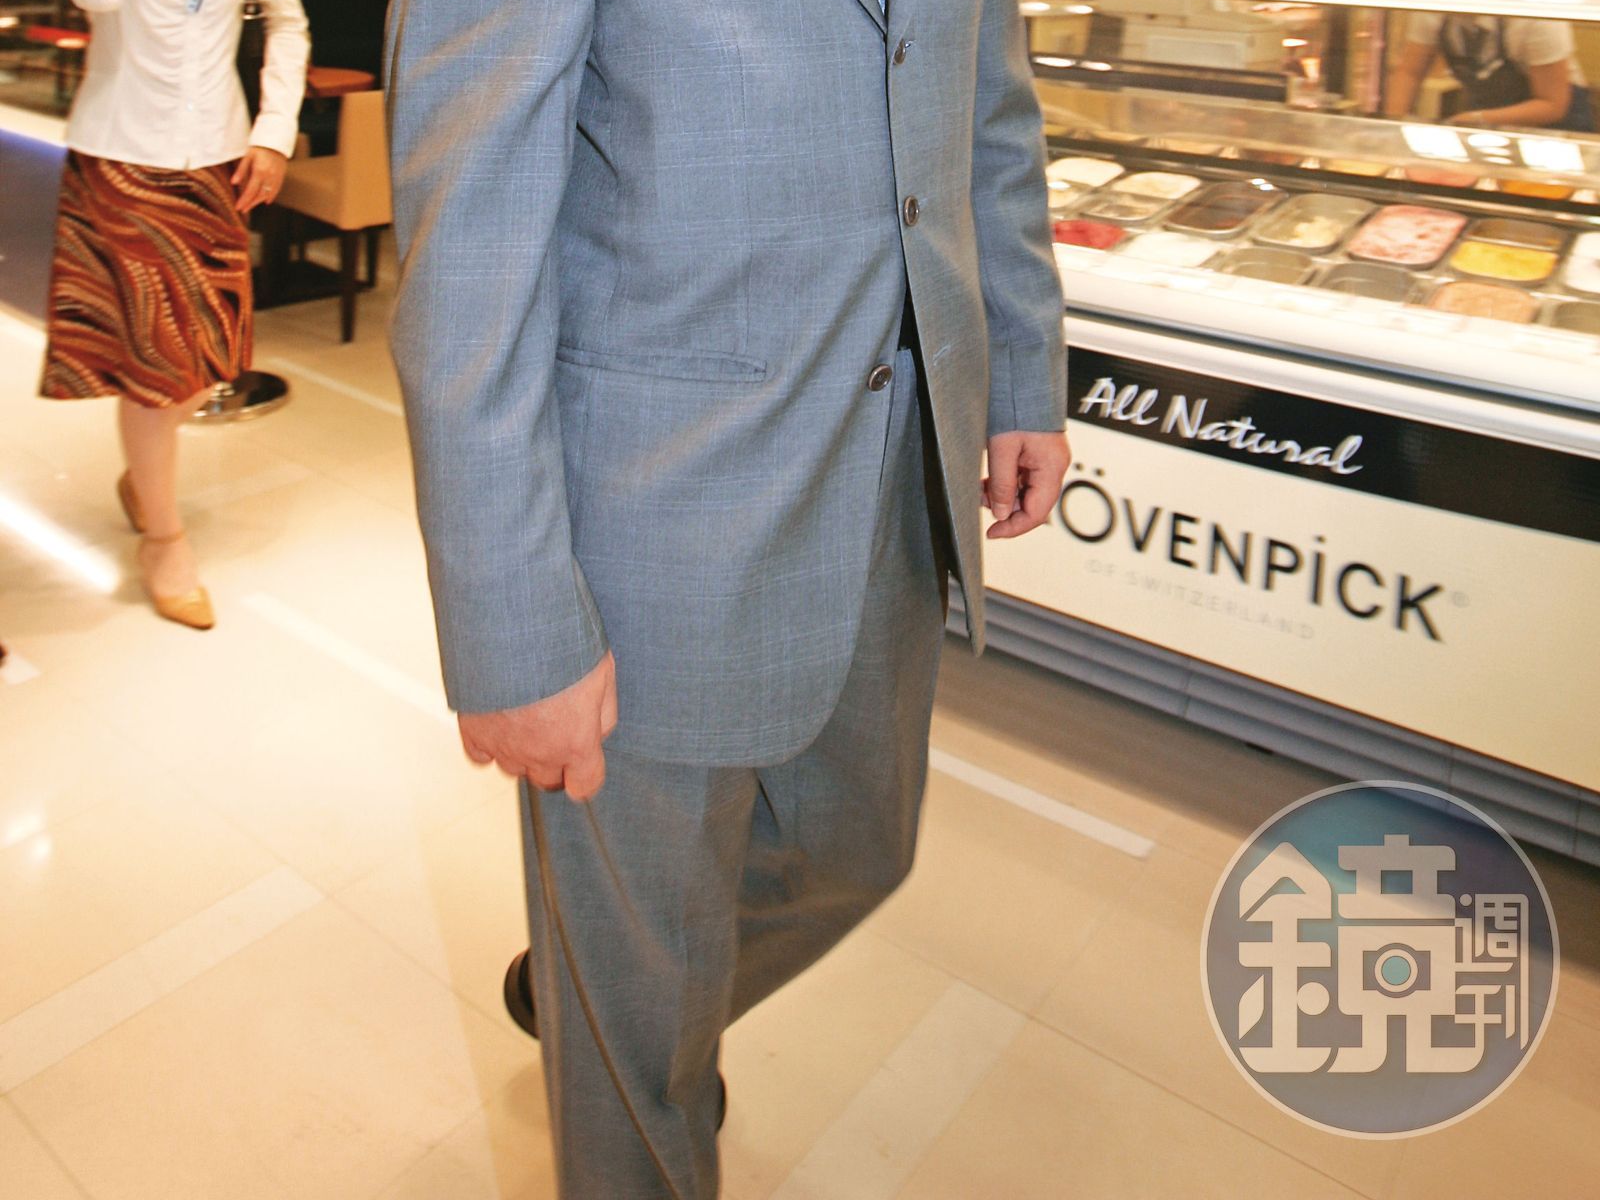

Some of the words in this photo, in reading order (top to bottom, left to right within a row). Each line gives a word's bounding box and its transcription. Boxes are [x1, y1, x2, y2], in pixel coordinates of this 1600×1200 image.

[1078, 377, 1158, 426] All
[1160, 395, 1363, 475] Natural
[1045, 462, 1446, 644] ÖVENPiCK
[1126, 570, 1315, 641] SWITZERLAND
